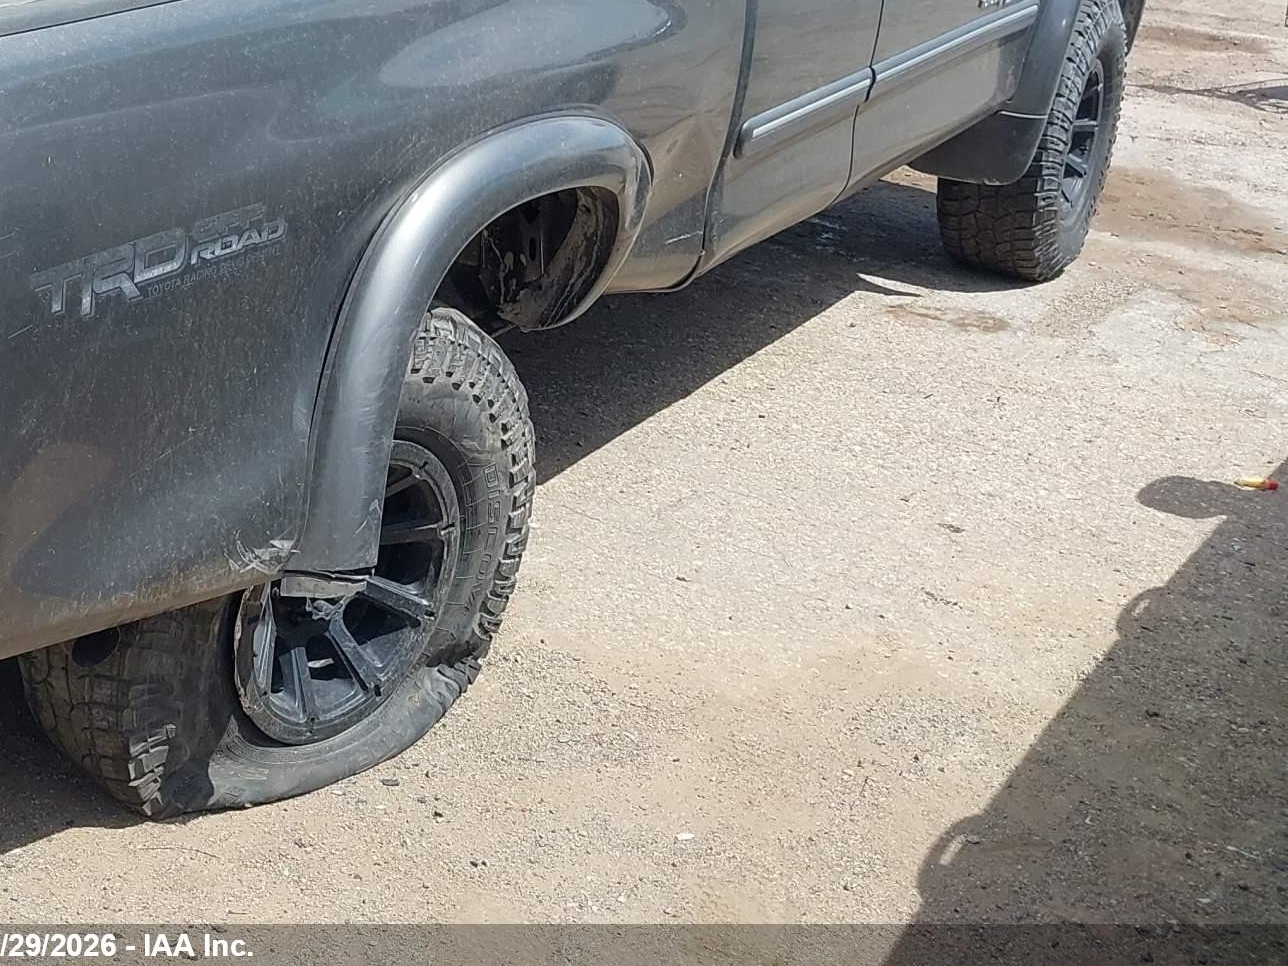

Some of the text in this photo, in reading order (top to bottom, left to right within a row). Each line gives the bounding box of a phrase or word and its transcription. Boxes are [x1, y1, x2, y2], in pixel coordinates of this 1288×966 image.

[190, 217, 288, 266] ROAD
[29, 227, 188, 317] TRD
[147, 278, 182, 298] TOYOTA
